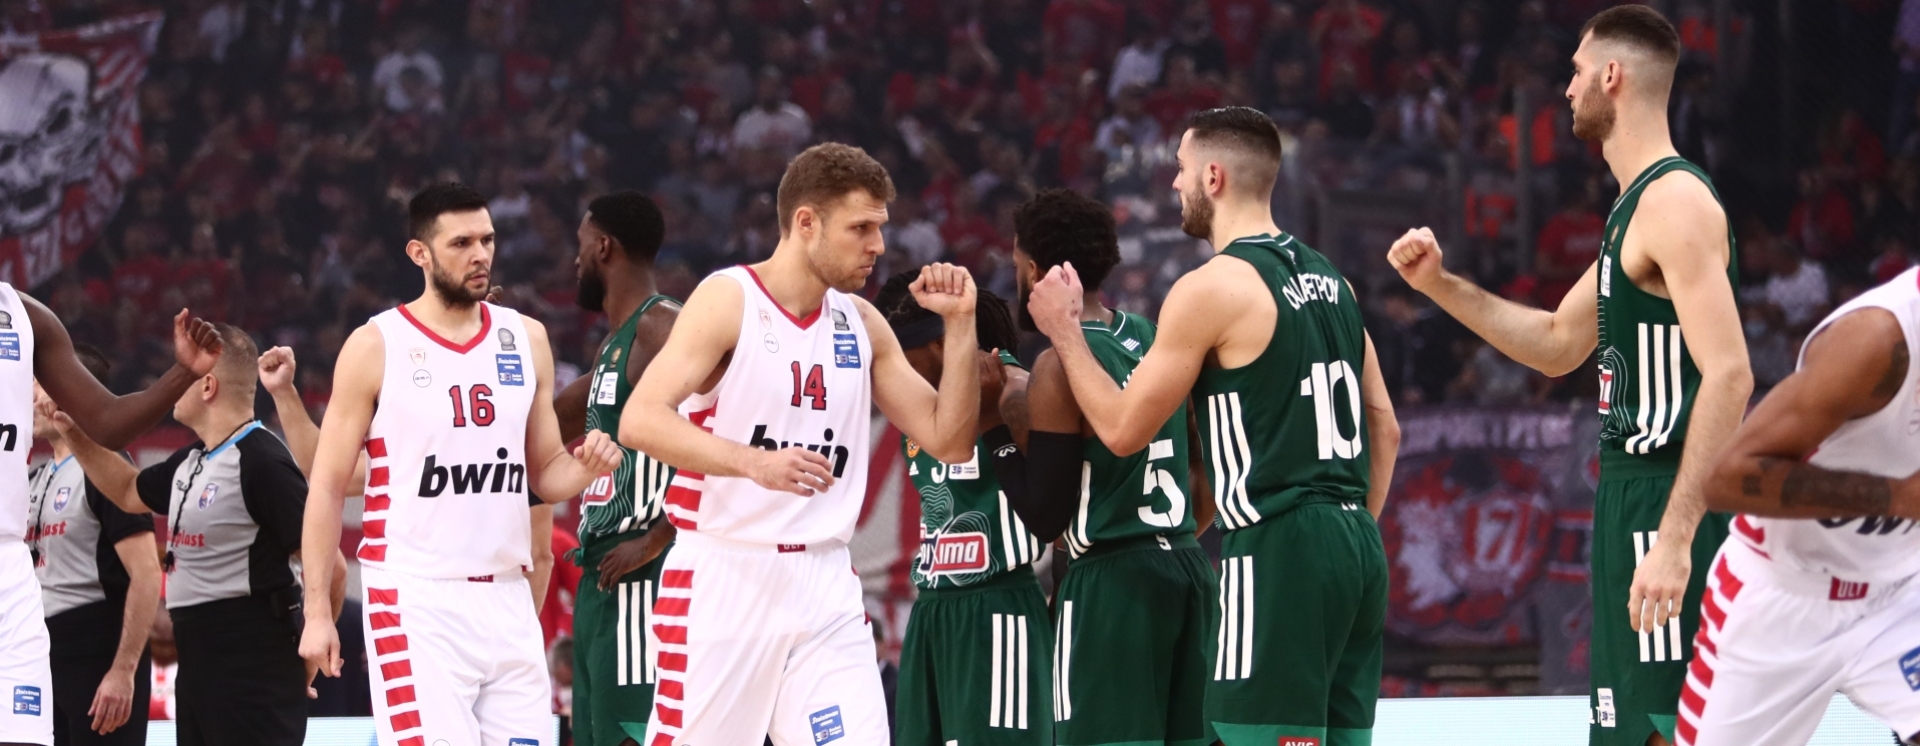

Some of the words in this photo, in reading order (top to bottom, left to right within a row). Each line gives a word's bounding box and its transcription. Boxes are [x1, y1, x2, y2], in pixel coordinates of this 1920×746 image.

[449, 384, 495, 427] 16
[791, 360, 826, 410] 14
[1301, 360, 1362, 459] 10
[418, 447, 524, 497] bwin
[1138, 439, 1186, 527] 5
